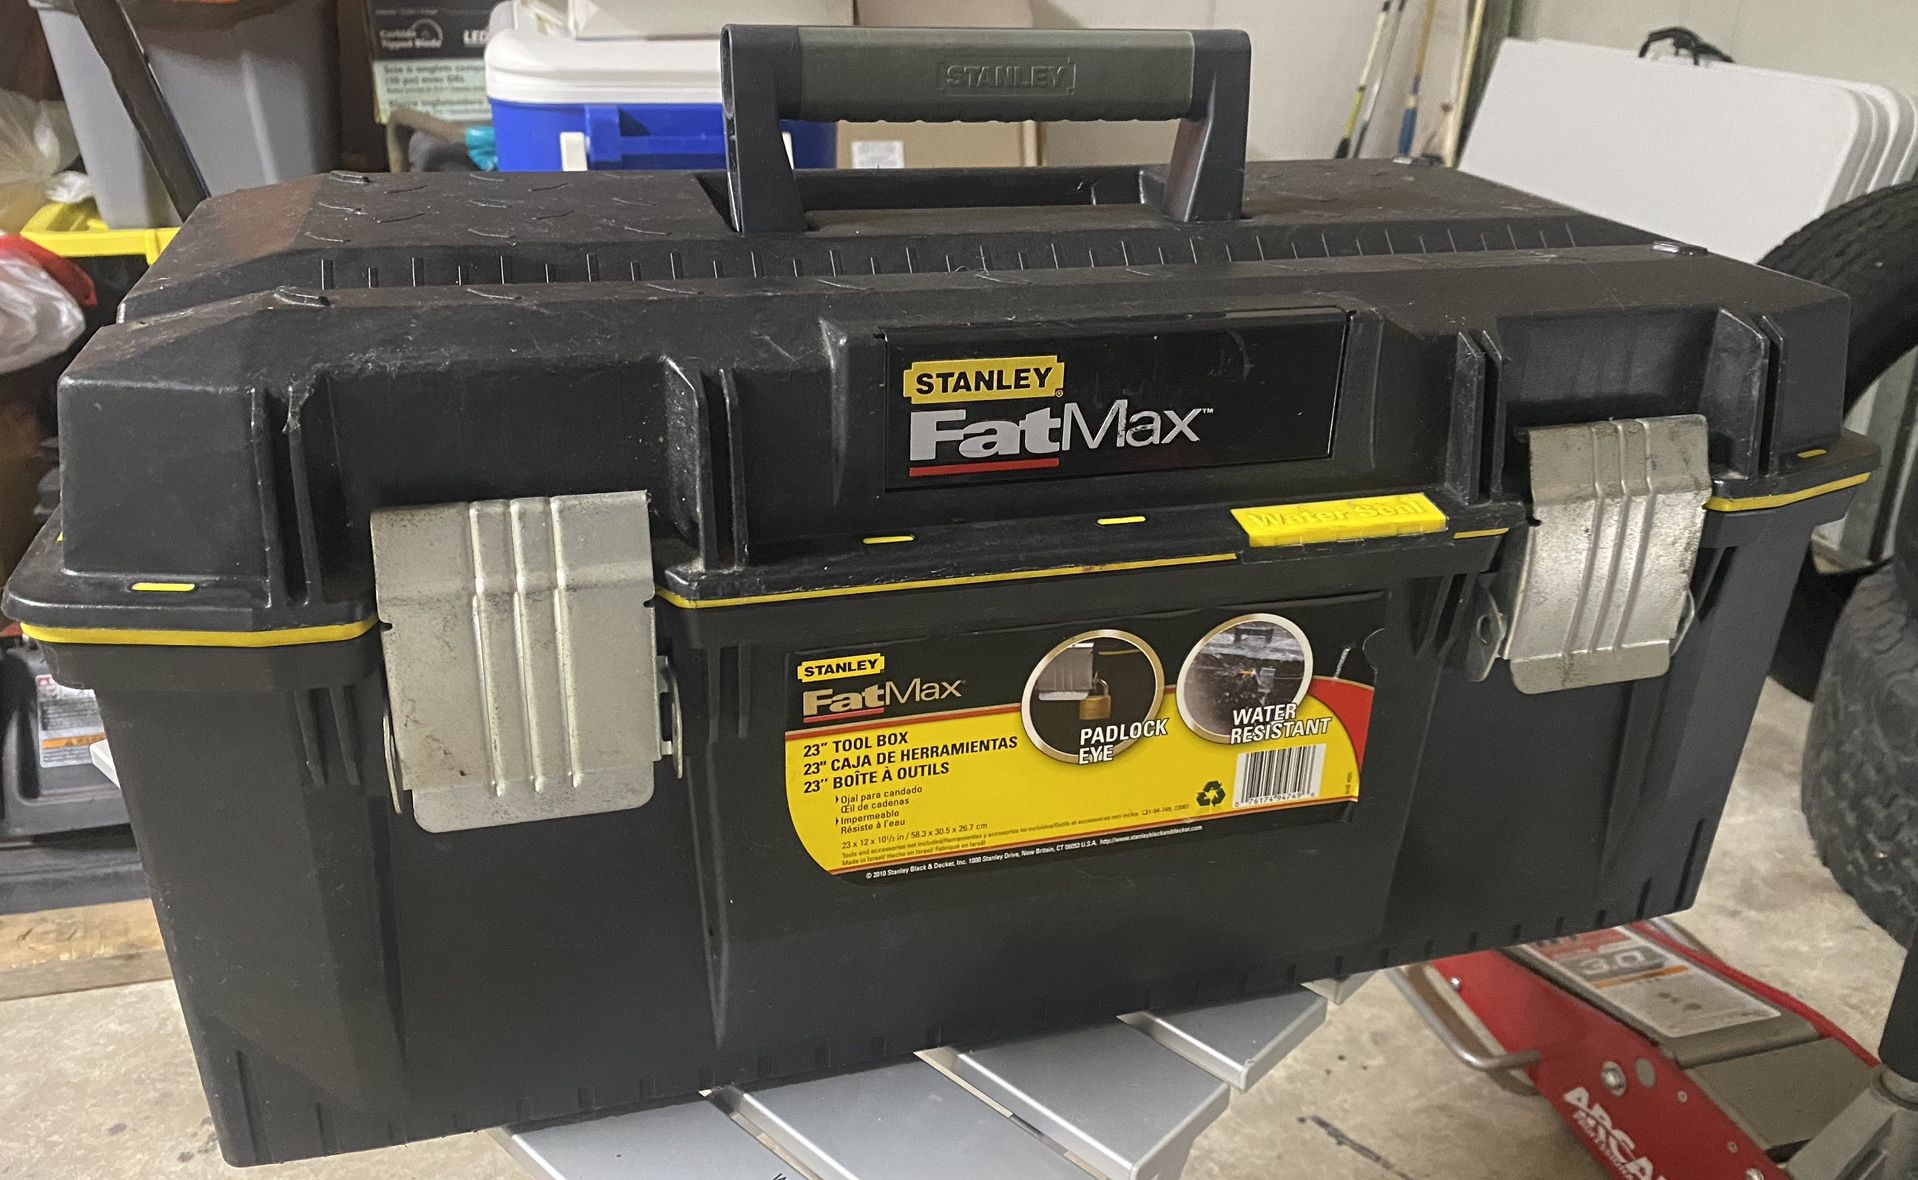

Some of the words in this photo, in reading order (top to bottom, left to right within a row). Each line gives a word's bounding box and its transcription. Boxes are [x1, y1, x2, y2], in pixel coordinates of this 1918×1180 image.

[946, 64, 1066, 88] STANLEY
[1250, 508, 1349, 528] Water
[1355, 498, 1427, 518] Seal
[804, 658, 879, 677] STANLEY
[1232, 703, 1297, 726] WATER
[833, 735, 873, 754] TOOL
[877, 731, 909, 749] BOX
[1079, 718, 1169, 746] PADLOCK
[1230, 717, 1332, 745] RESISTANT
[831, 753, 872, 772] CAJA
[877, 750, 896, 765] DE
[901, 736, 1018, 762] HERRAMIENTAS
[1078, 744, 1114, 765] EYE
[833, 769, 878, 790] BOÎTE
[881, 765, 893, 783] À
[898, 761, 950, 780] OUTILS
[841, 794, 859, 805] Ojal
[861, 792, 881, 803] para
[884, 786, 923, 798] candado
[857, 803, 869, 812] de
[871, 798, 910, 809] cadenas
[841, 810, 900, 825] Impermeable
[841, 823, 874, 835] Résiste
[876, 820, 881, 829] à
[842, 841, 851, 849] 23
[860, 838, 869, 846] 12
[910, 829, 927, 838] 58.3
[935, 826, 951, 835] 30.5
[959, 823, 974, 833] 26.7
[976, 822, 988, 831] cm
[873, 870, 887, 878] 2010
[887, 867, 910, 877] Stanley
[910, 864, 927, 873] Black
[982, 852, 1004, 862] Stanley
[1021, 849, 1035, 857] New
[1563, 1086, 1668, 1180] ARCA
